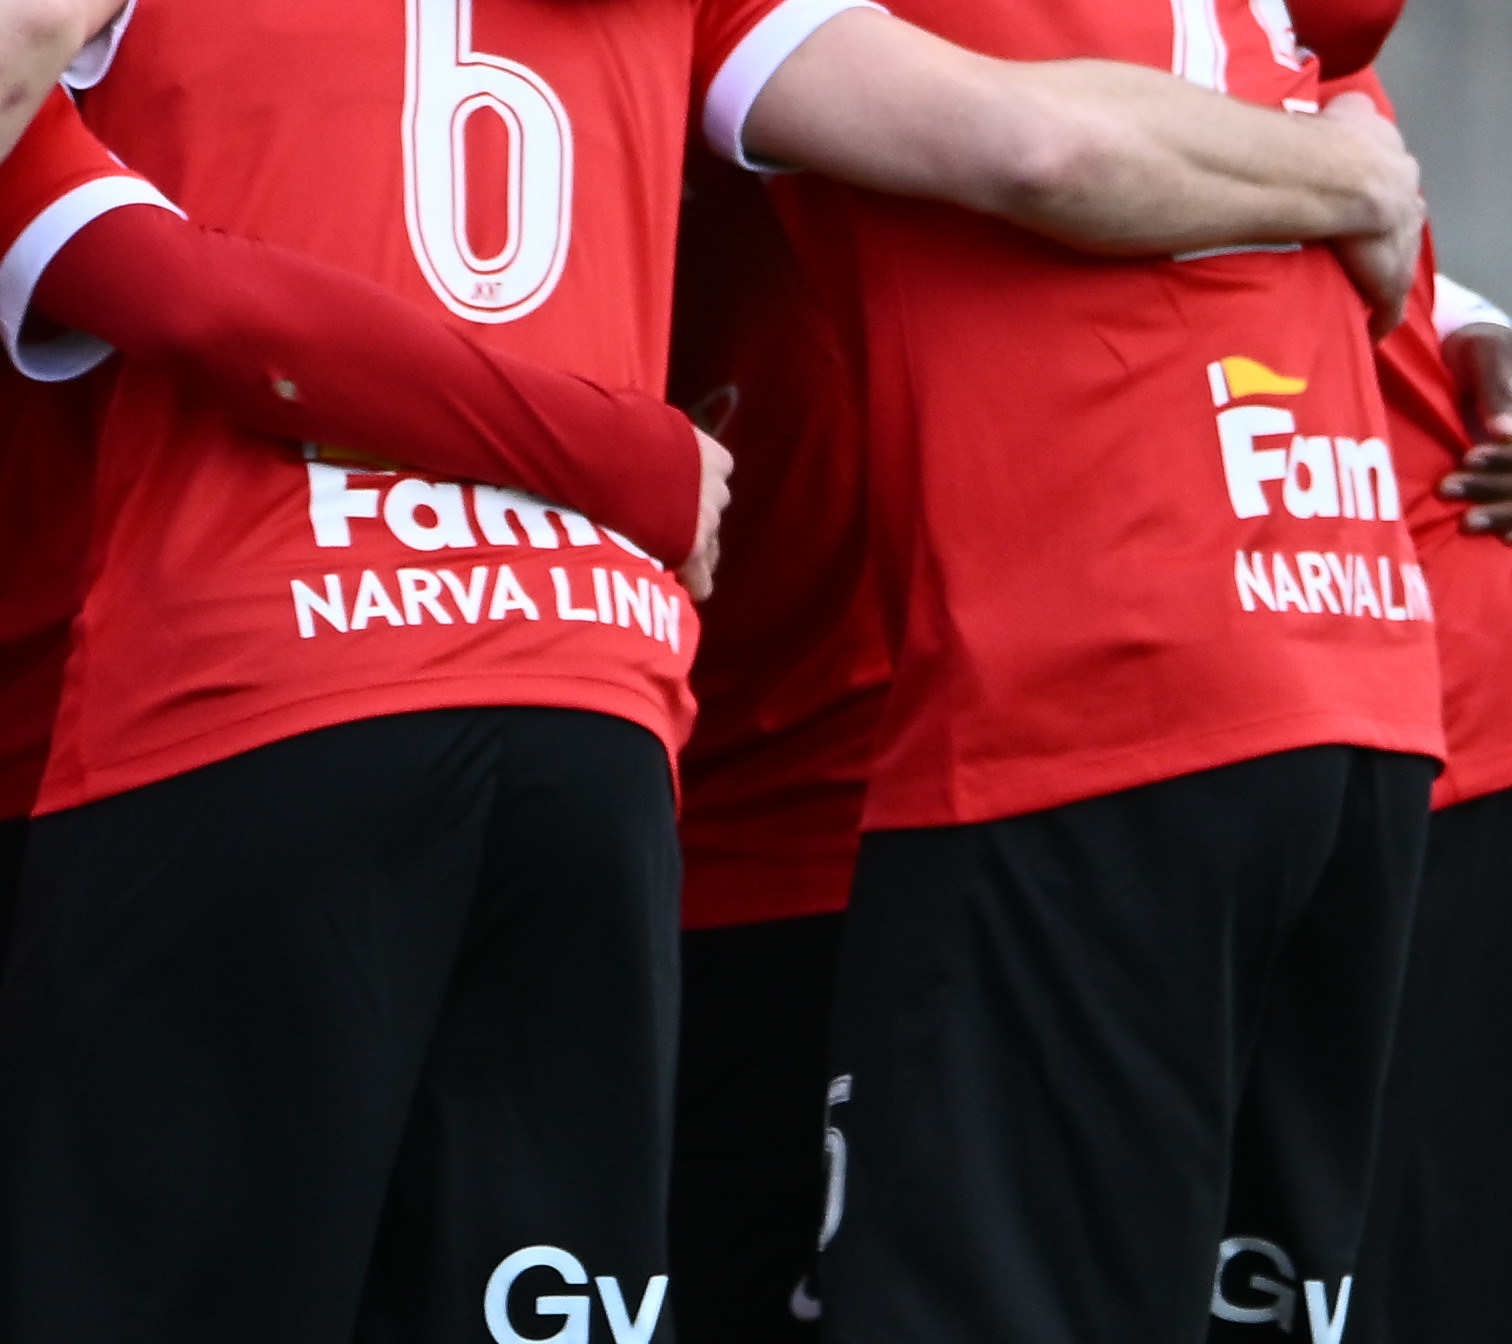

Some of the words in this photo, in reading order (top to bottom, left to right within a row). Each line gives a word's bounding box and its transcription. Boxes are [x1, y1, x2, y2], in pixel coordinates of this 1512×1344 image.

[308, 461, 665, 573] Fam
[290, 565, 540, 639] NARVA
[549, 567, 680, 655] LINN
[1234, 549, 1383, 619] NARVA
